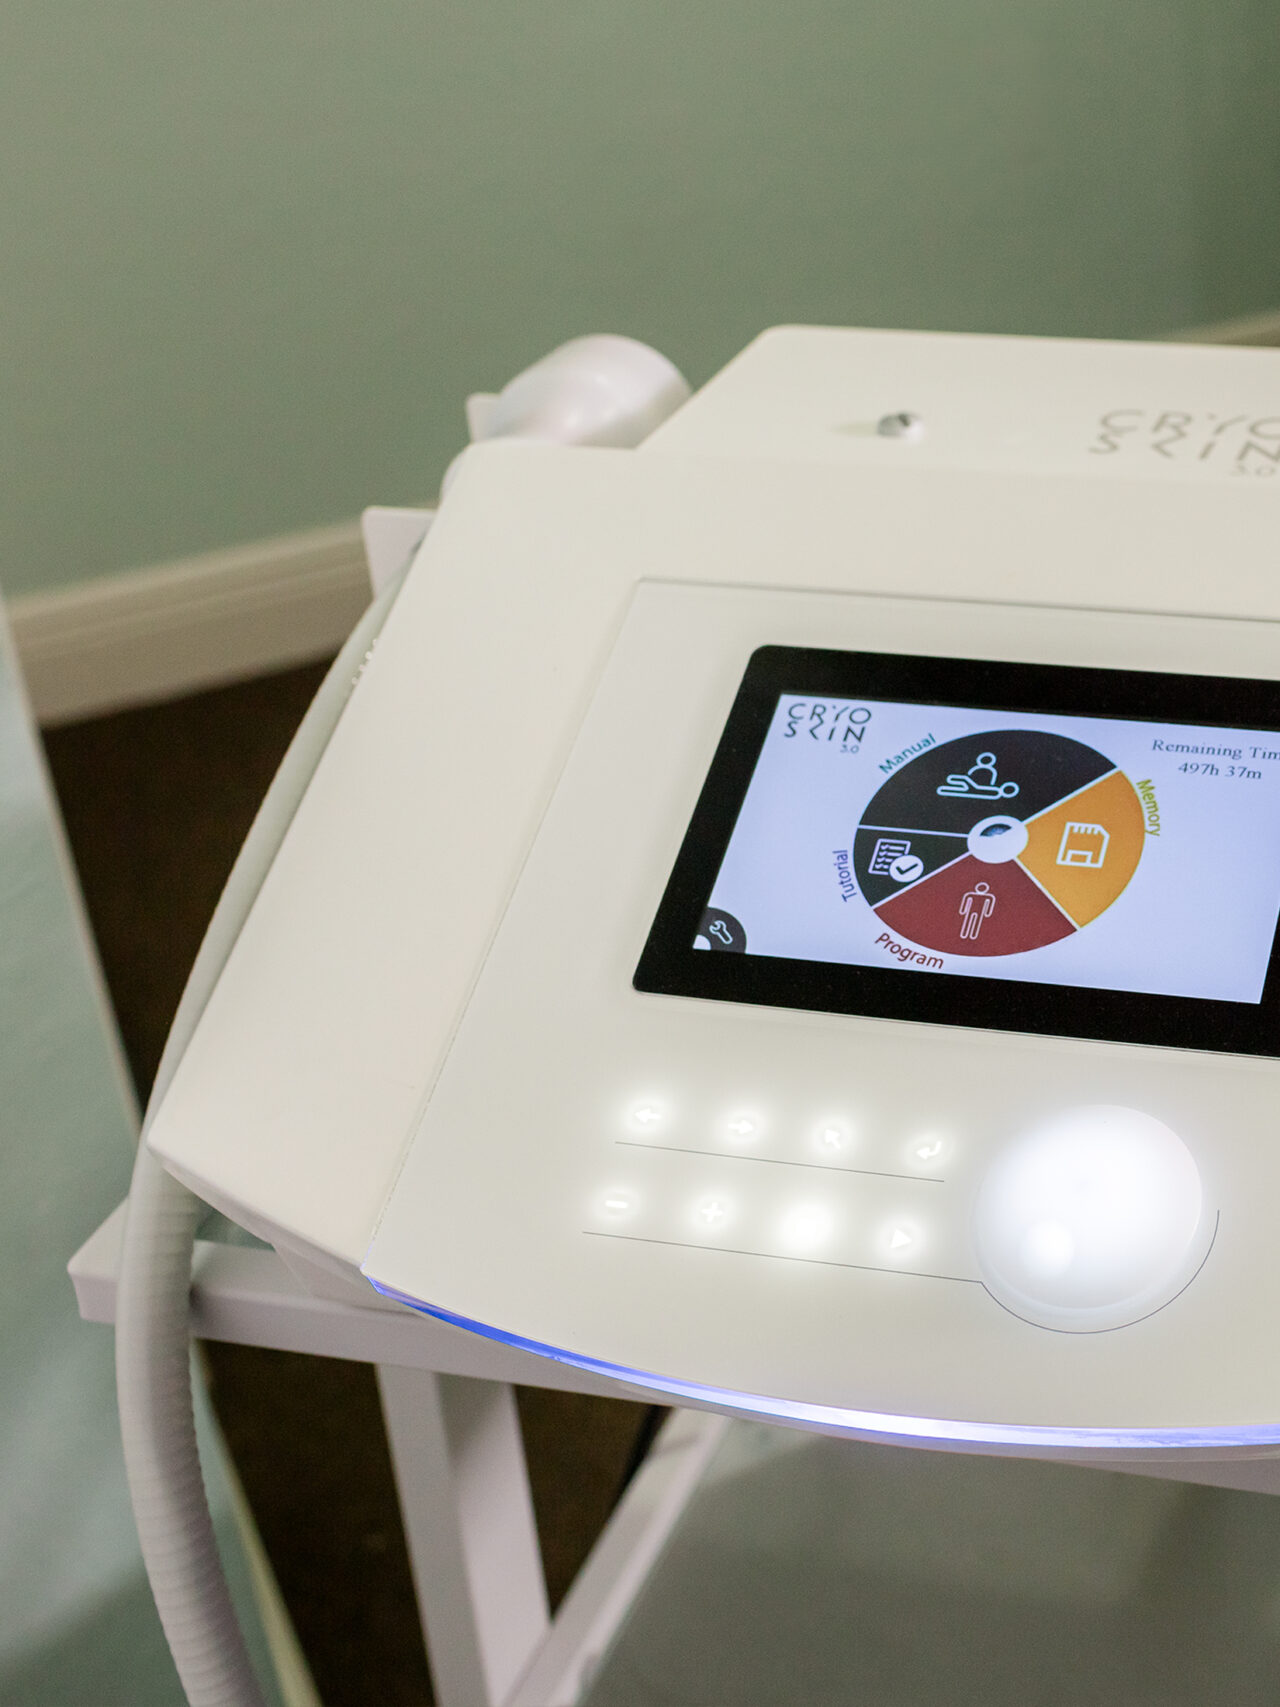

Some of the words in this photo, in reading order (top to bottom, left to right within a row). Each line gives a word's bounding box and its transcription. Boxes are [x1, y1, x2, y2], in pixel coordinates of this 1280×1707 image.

[788, 703, 872, 725] CRYO
[879, 733, 936, 774] Manual
[1152, 739, 1242, 761] Remaining
[1178, 762, 1220, 776] 497h
[1225, 766, 1262, 780] 37m
[1136, 779, 1160, 836] Memory
[832, 849, 857, 902] Tutorial
[874, 932, 944, 969] Program
